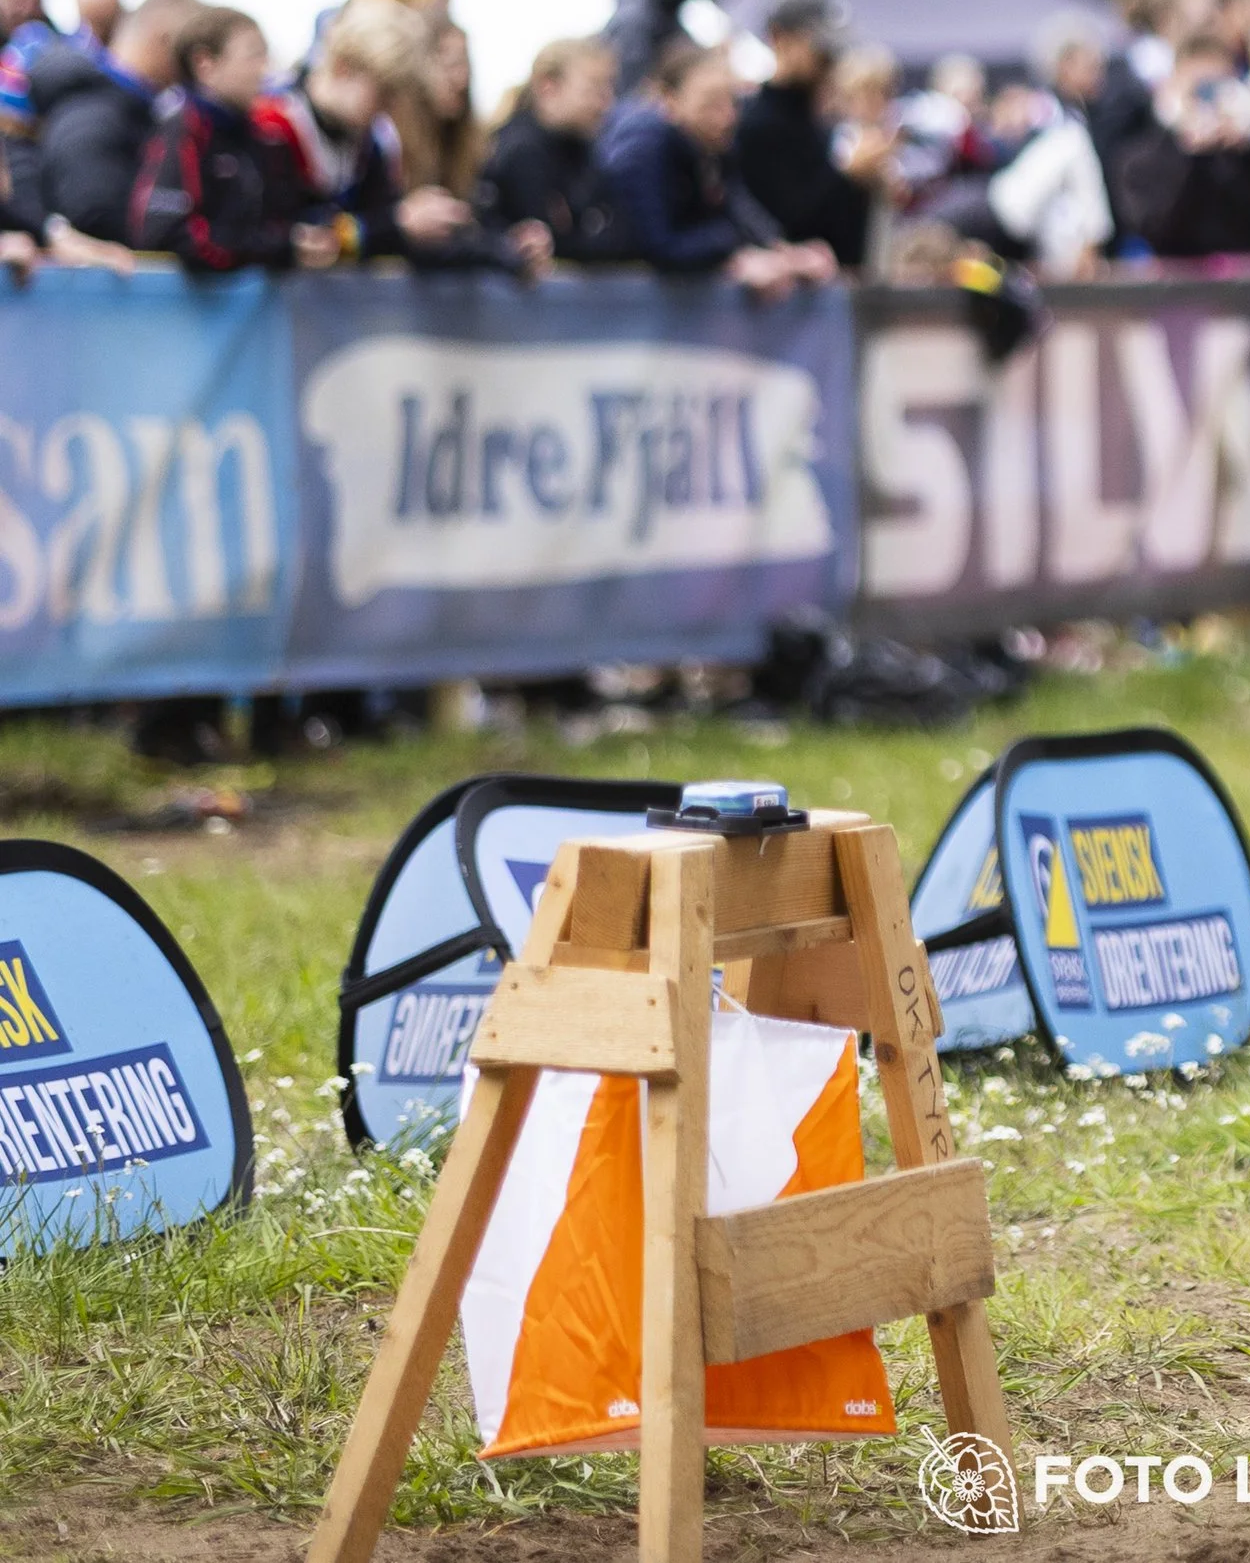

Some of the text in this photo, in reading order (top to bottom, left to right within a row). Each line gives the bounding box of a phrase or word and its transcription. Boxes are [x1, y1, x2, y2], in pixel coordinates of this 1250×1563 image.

[1071, 822, 1164, 906] SVENSK
[0, 956, 59, 1049] SK
[1096, 914, 1241, 1010] ORIENTERING
